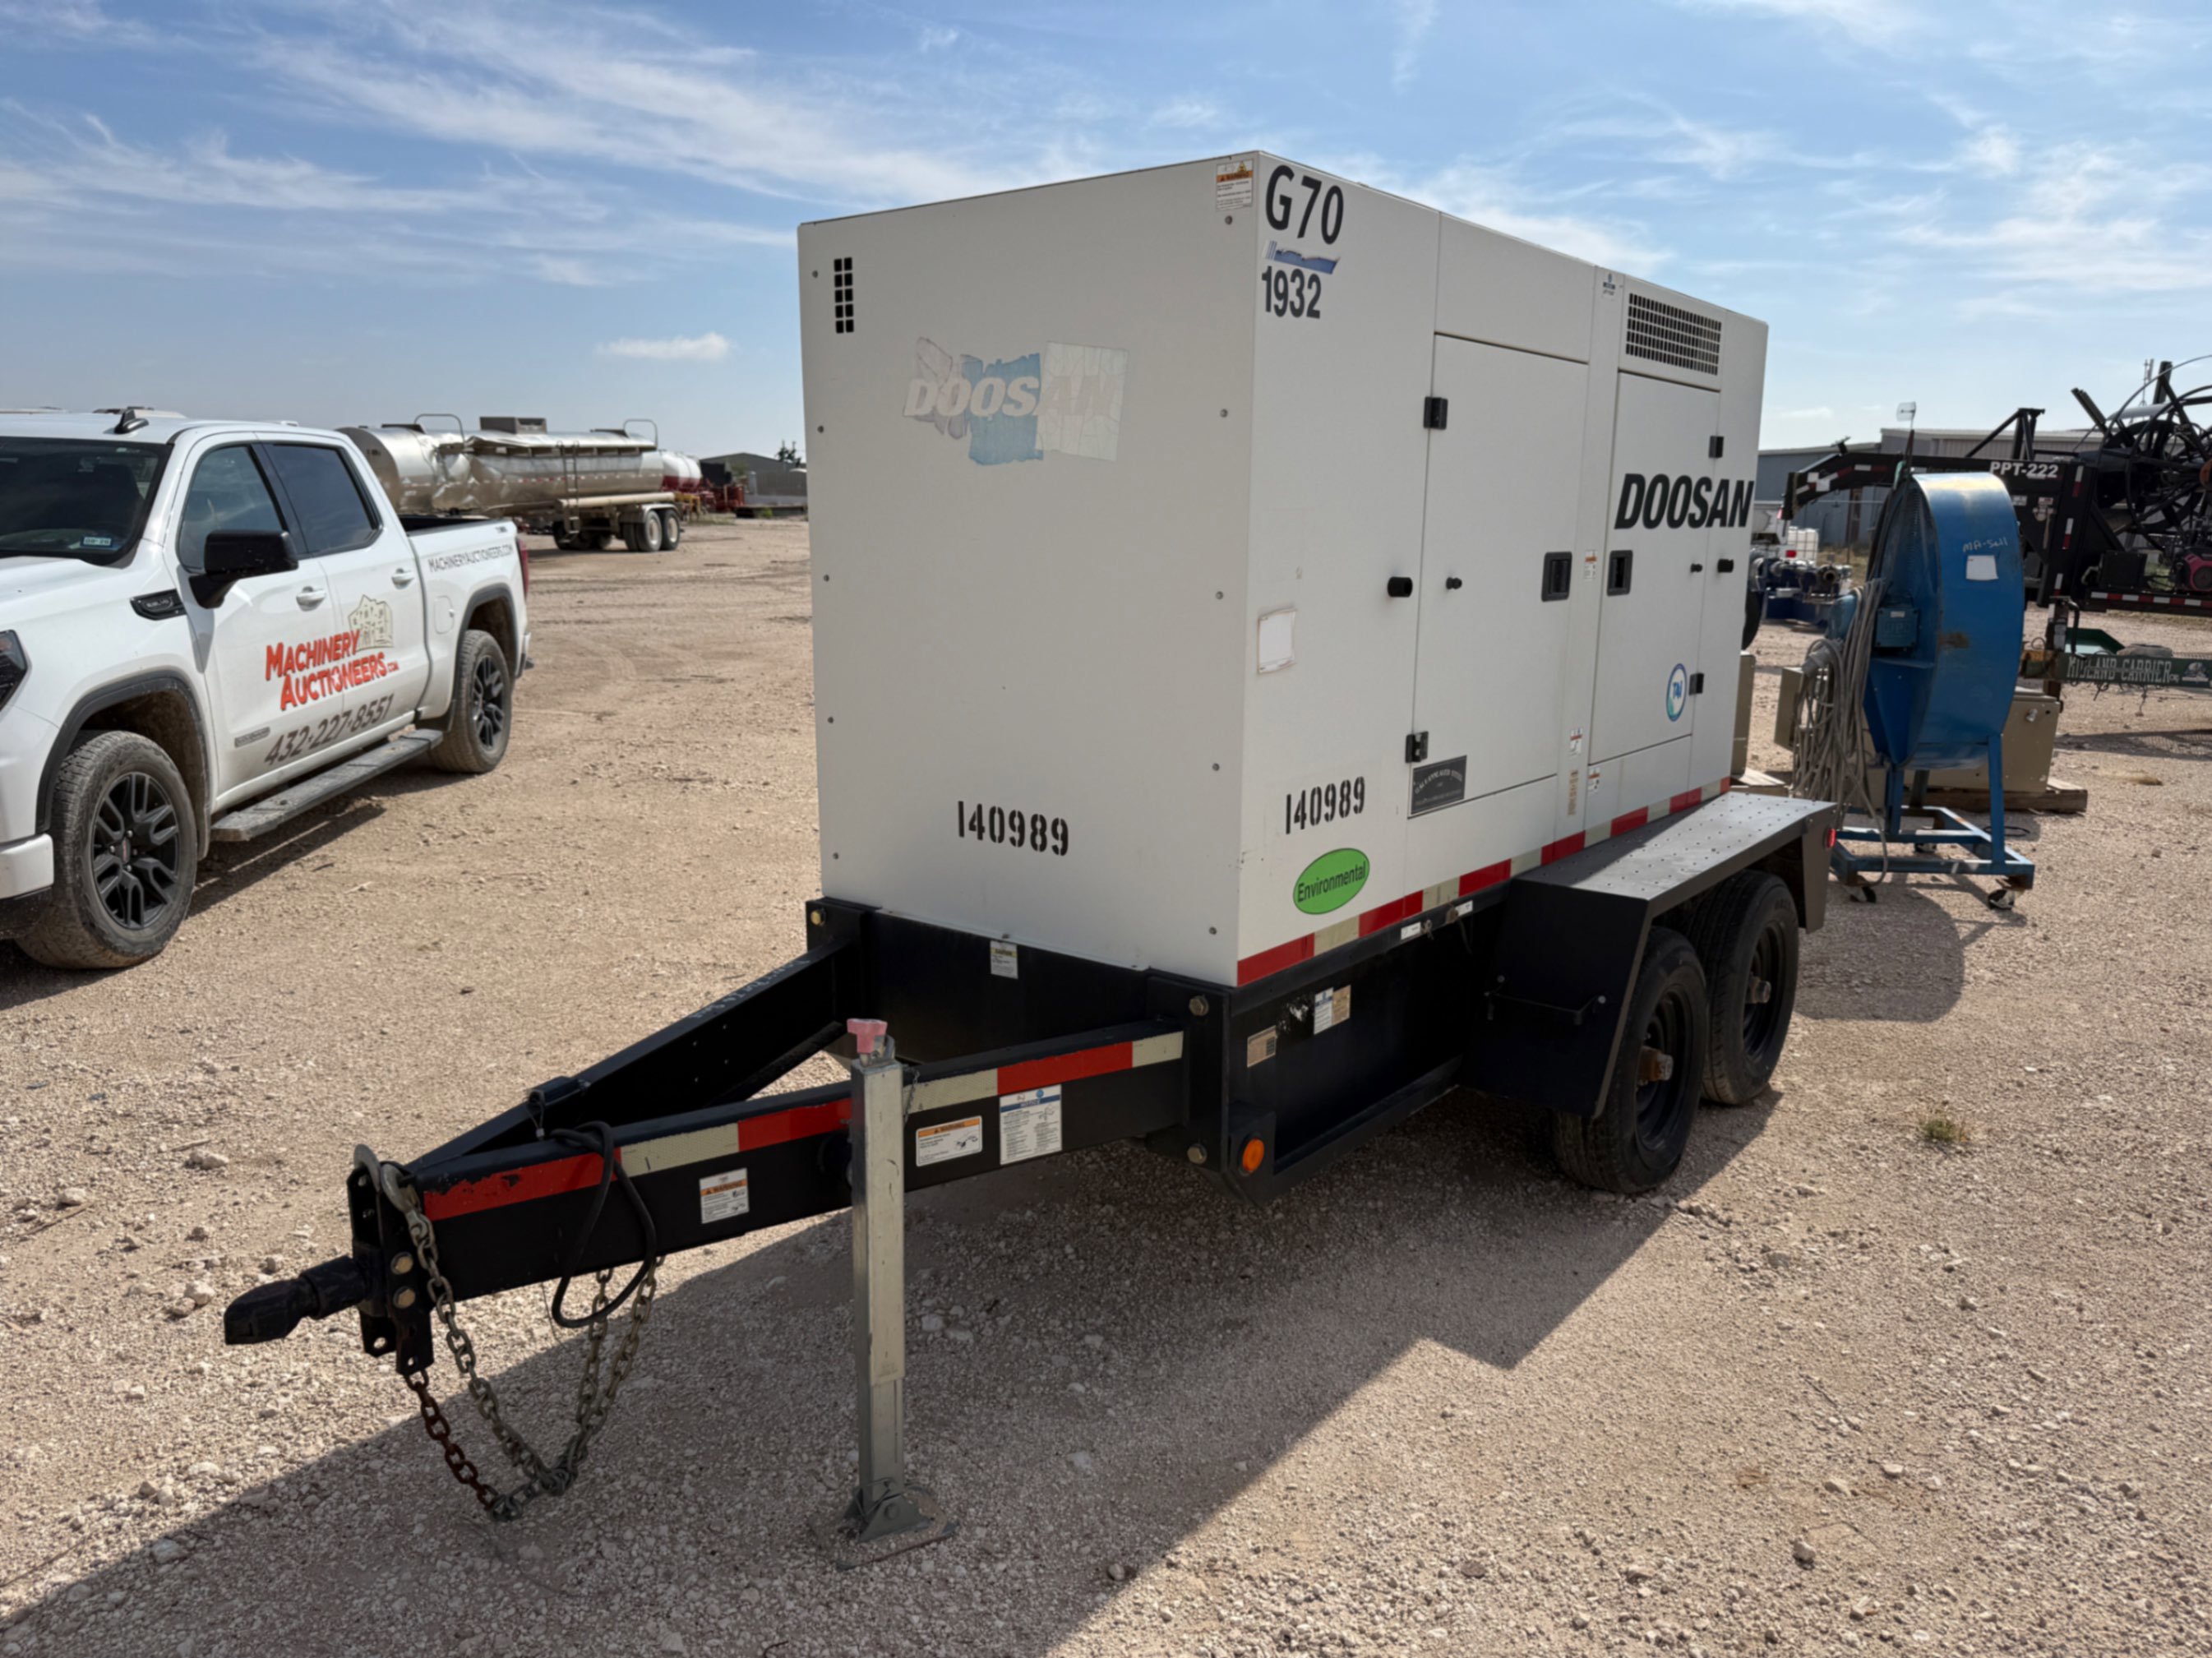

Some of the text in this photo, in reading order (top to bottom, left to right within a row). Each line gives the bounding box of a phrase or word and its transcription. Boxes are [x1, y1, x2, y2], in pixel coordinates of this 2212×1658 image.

[1266, 164, 1344, 245] G70
[1262, 266, 1322, 319] 1932
[1989, 461, 2059, 478] PPT-222
[1614, 473, 1755, 530] DOOSAN
[266, 629, 361, 681] MACHINERY
[958, 801, 1069, 857] 140989
[1286, 776, 1365, 835] 140989
[1296, 861, 1367, 903] Environmental
